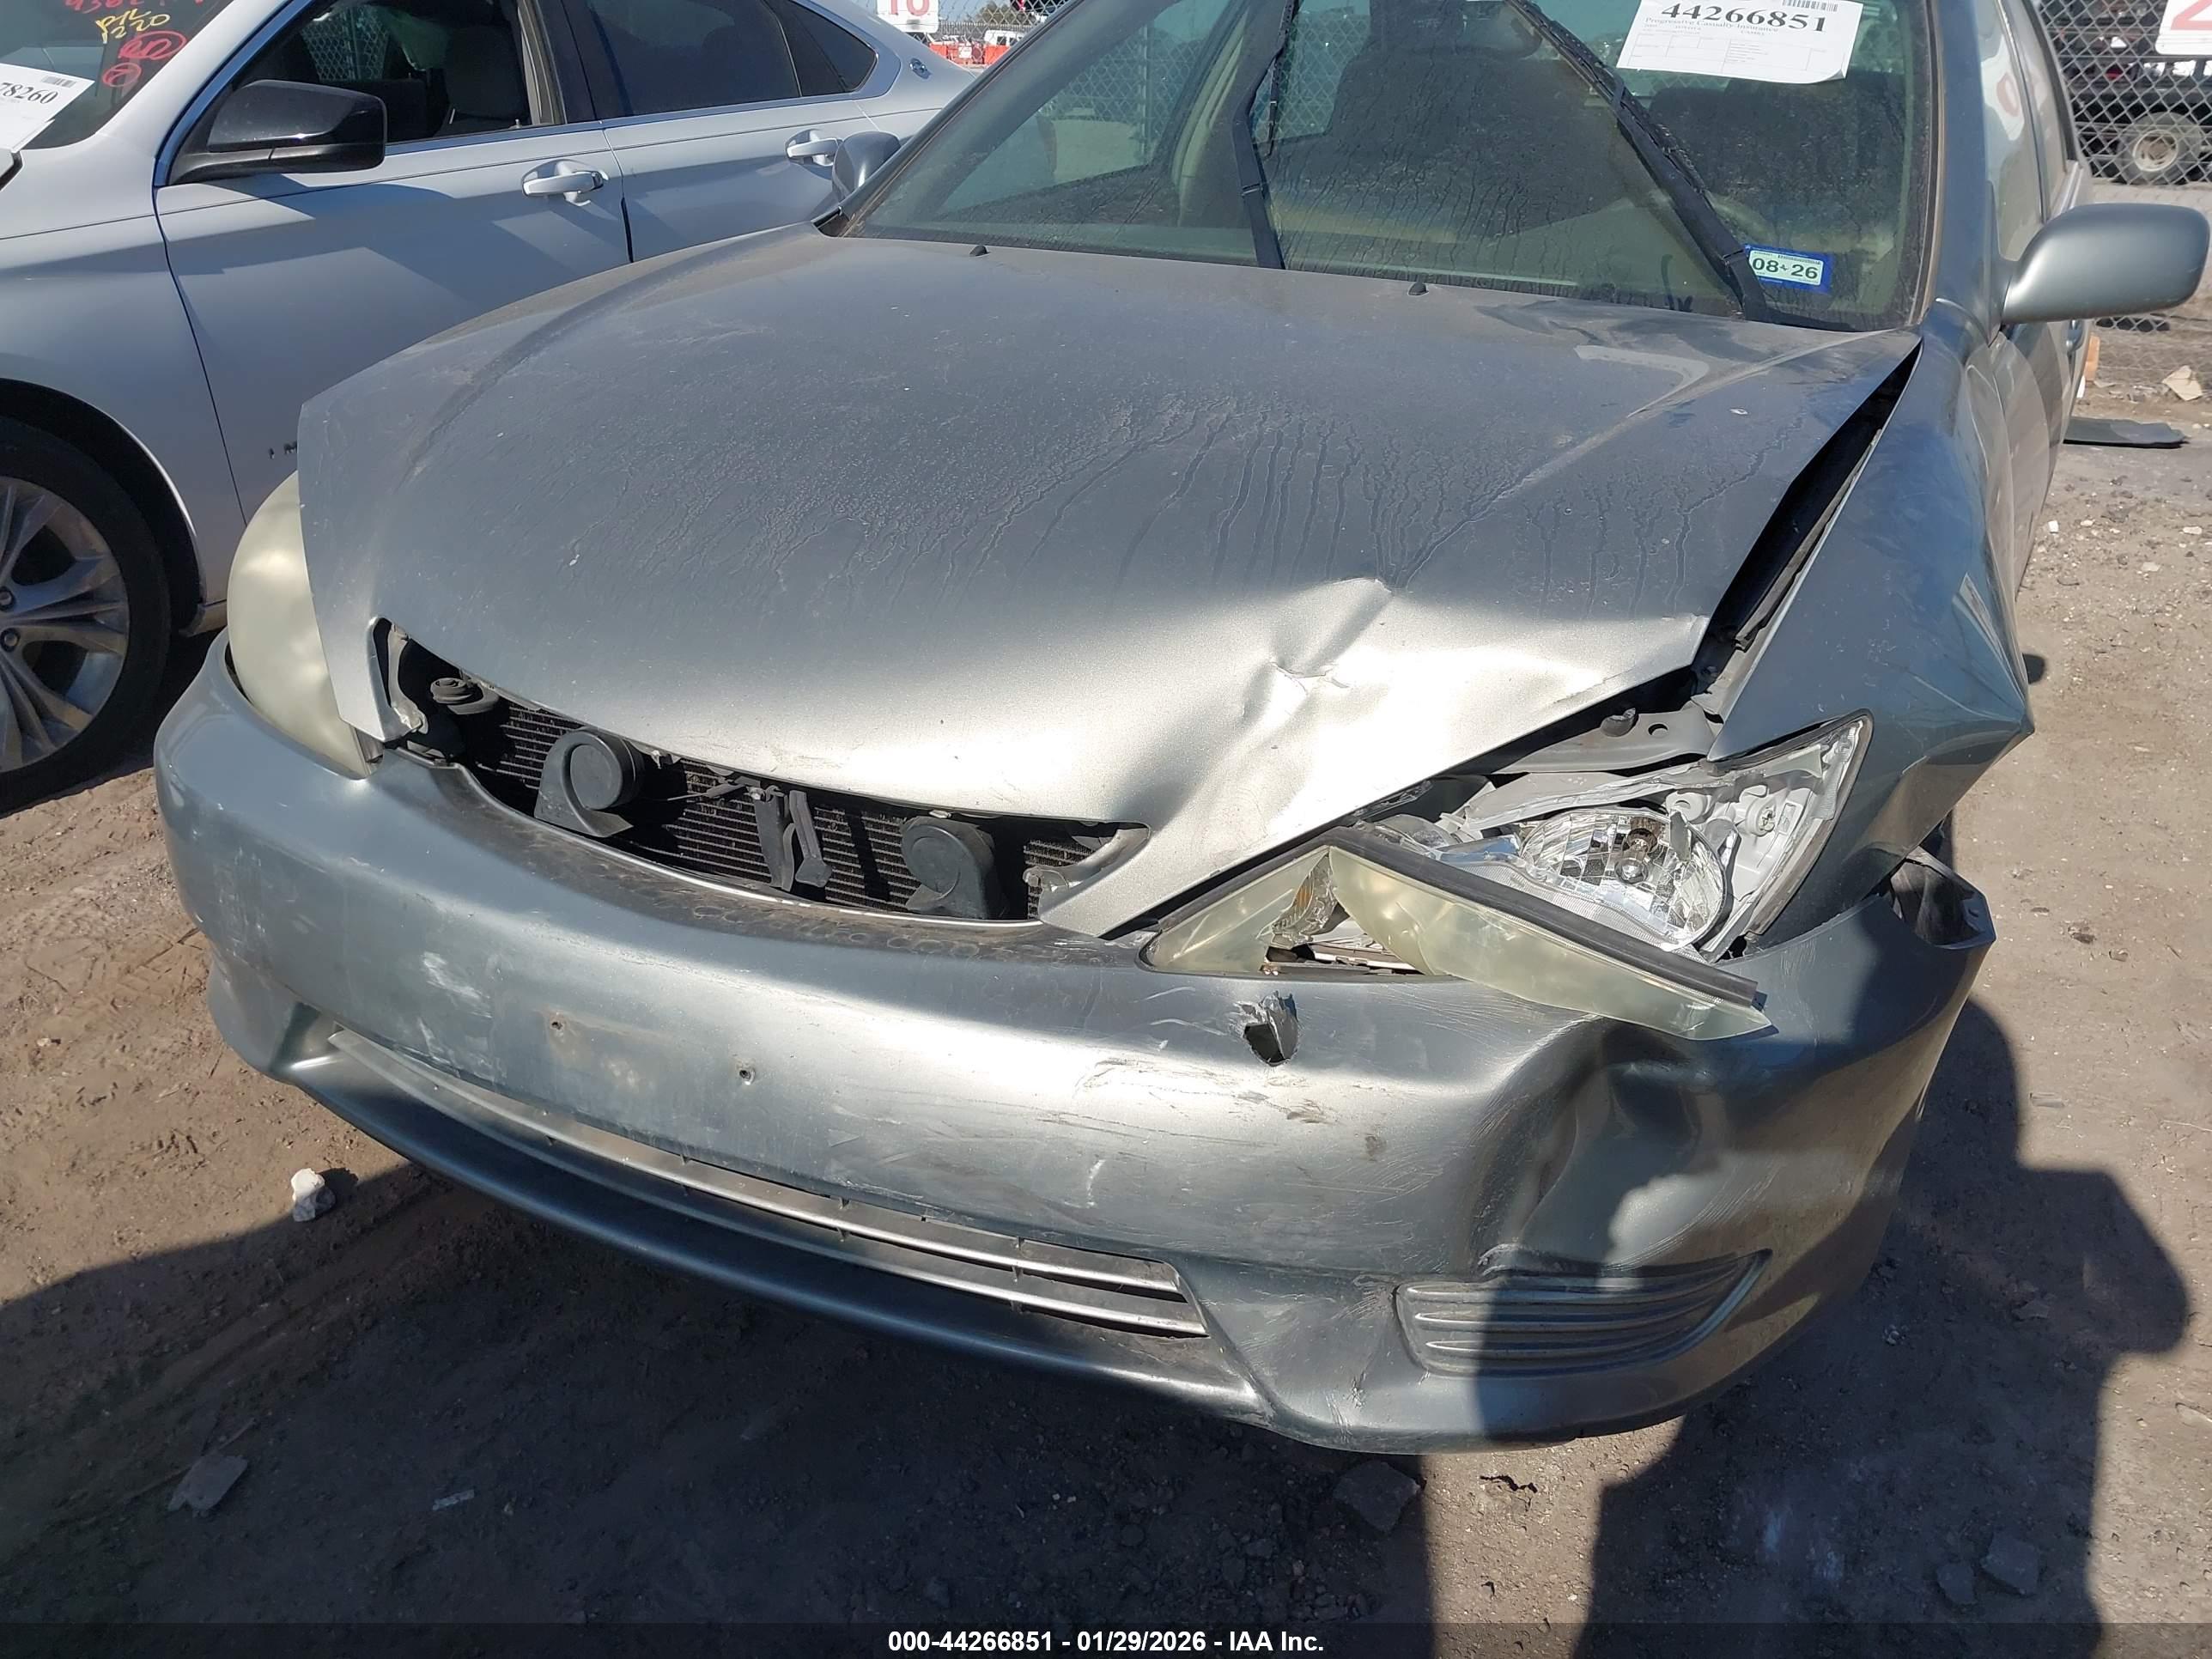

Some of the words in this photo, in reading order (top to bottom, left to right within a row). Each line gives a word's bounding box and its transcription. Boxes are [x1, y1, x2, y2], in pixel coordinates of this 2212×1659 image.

[1661, 3, 1826, 32] 44266851
[1752, 258, 1779, 273] 08
[1790, 264, 1820, 279] 26
